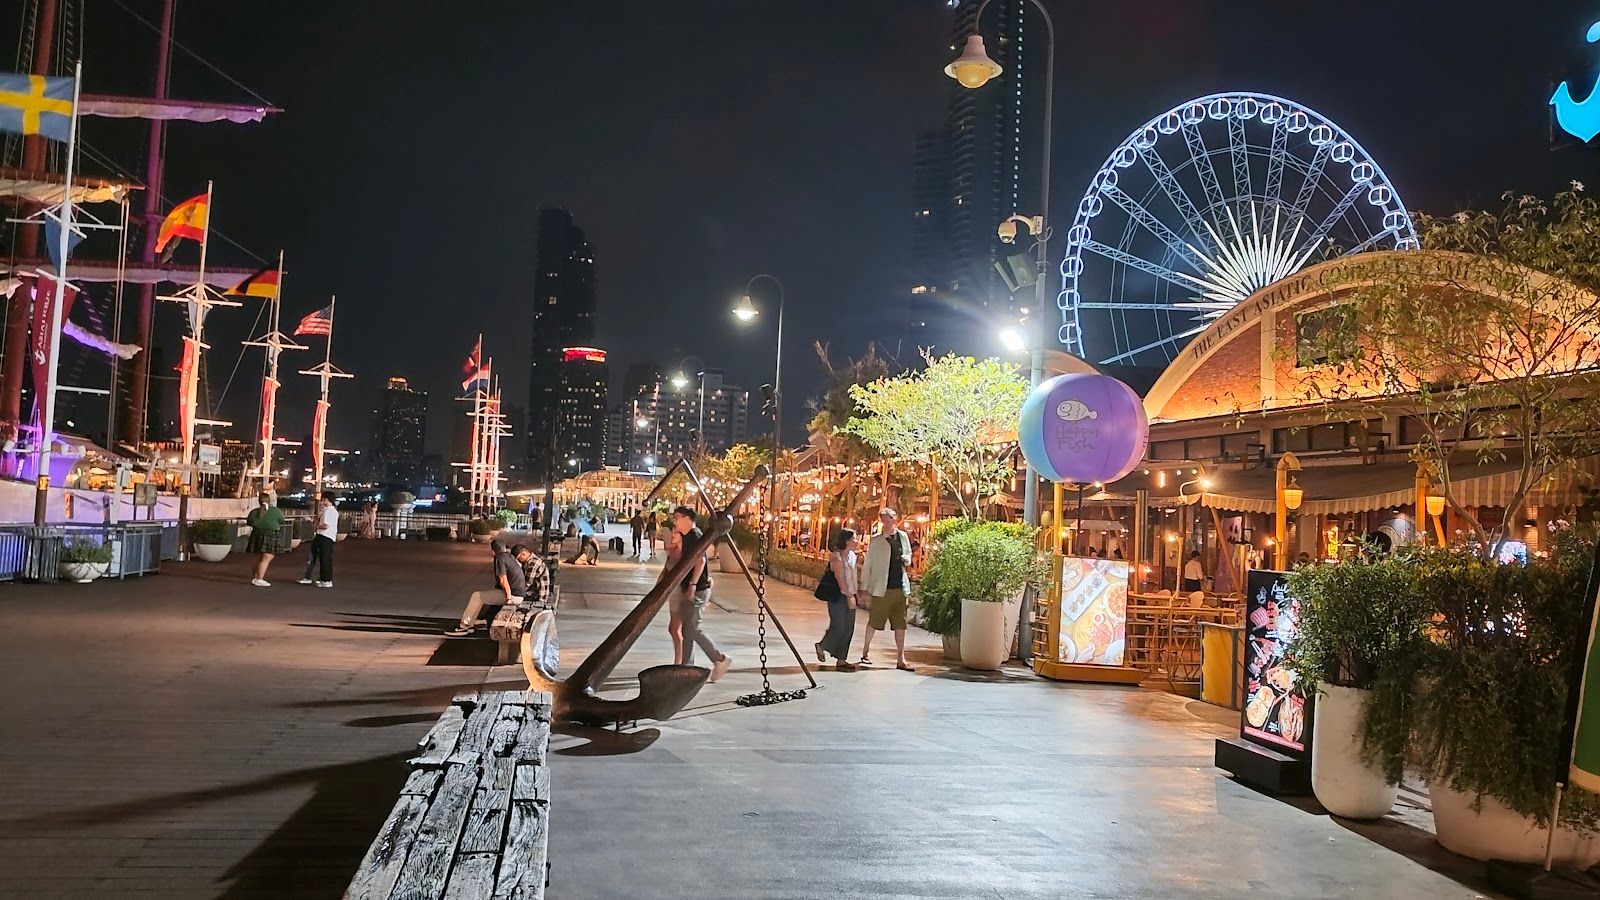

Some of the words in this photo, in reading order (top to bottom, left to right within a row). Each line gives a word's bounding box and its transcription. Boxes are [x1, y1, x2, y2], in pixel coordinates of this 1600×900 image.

[1191, 337, 1214, 360] THE
[1216, 307, 1248, 339] EAST
[1253, 275, 1312, 316] ASIATIC
[1056, 437, 1096, 453] Fish
